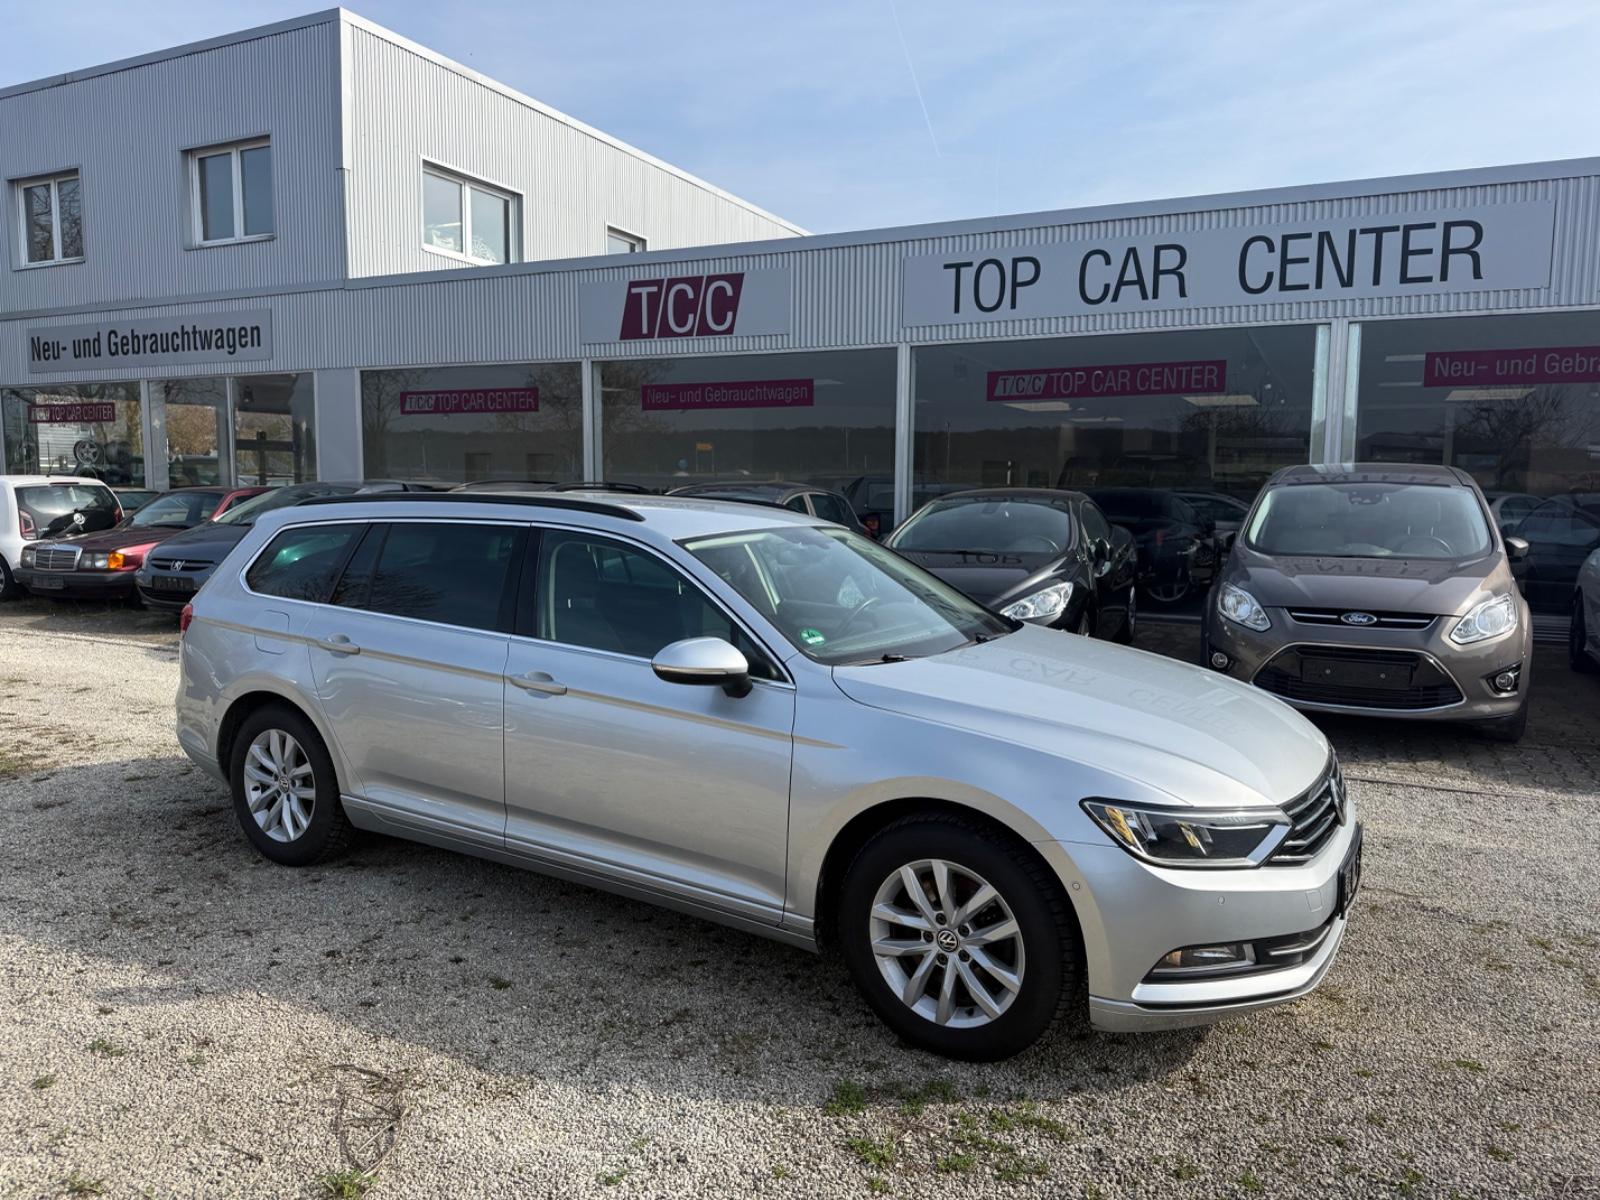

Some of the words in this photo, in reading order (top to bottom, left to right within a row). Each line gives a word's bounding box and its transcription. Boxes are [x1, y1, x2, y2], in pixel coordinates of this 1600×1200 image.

[943, 256, 1041, 314] TOP
[1079, 243, 1188, 305] CAR
[1238, 219, 1484, 295] CENTER
[630, 279, 734, 335] TCC
[31, 336, 67, 362] Neu-
[73, 331, 101, 359] und
[107, 324, 262, 356] Gebrauchtwagen
[1434, 356, 1489, 378] Neu-
[1495, 354, 1537, 376] und
[1050, 371, 1087, 394] TOP
[1092, 369, 1131, 393] CAR
[1136, 365, 1219, 391] CENTER
[438, 393, 460, 410] TOP
[462, 391, 486, 410] CAR
[487, 390, 536, 409] CENTER
[647, 389, 677, 405] Neu-
[680, 385, 702, 404] und
[704, 383, 809, 404] Gebrauchtwagen
[50, 406, 66, 421] TOP
[66, 405, 82, 421] CAR
[82, 404, 114, 420] CENTER
